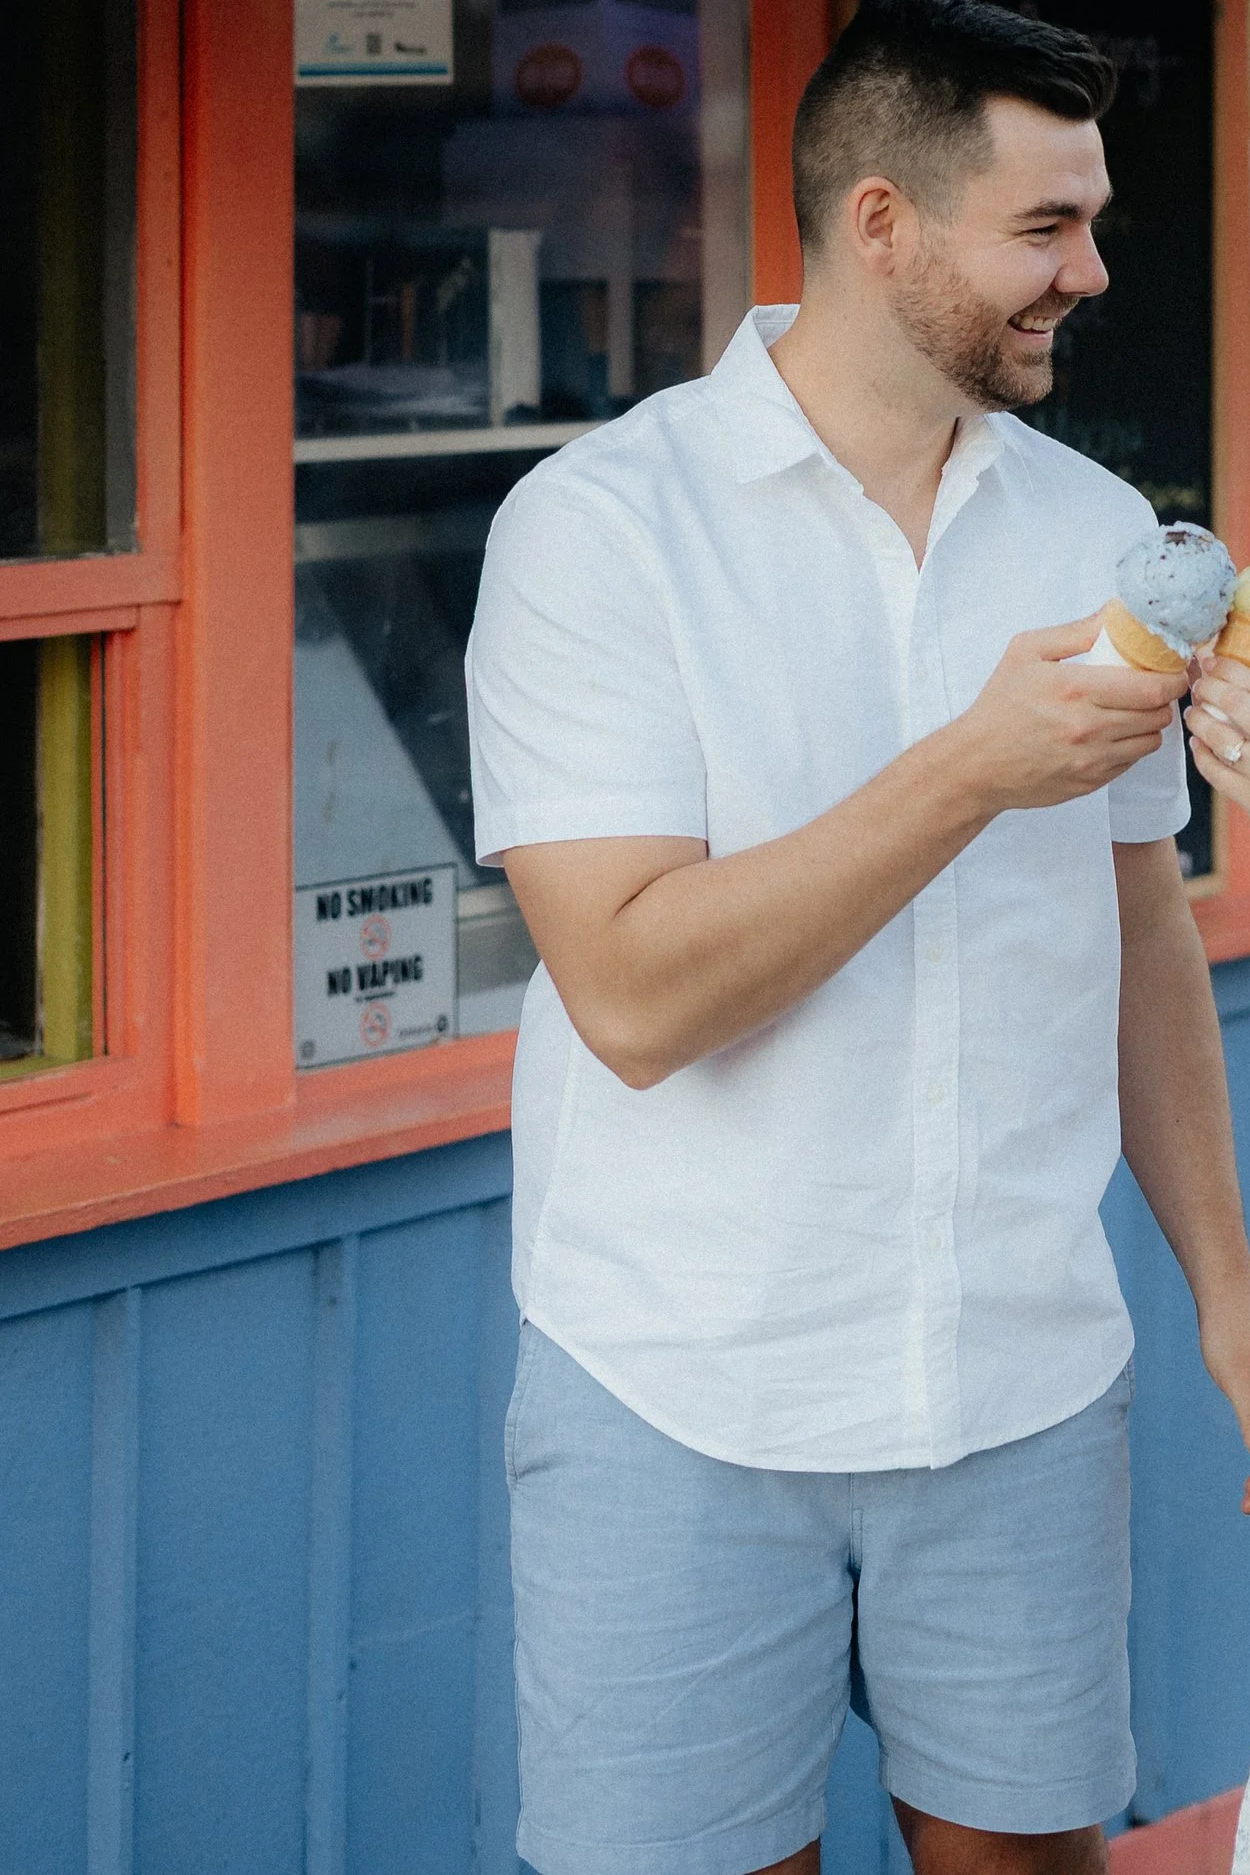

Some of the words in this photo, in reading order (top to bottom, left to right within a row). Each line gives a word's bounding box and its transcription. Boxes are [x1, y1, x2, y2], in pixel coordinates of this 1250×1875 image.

[317, 890, 342, 921] NO
[348, 877, 432, 916] SMOKING
[328, 967, 351, 997] NO
[357, 954, 422, 991] VAPING
